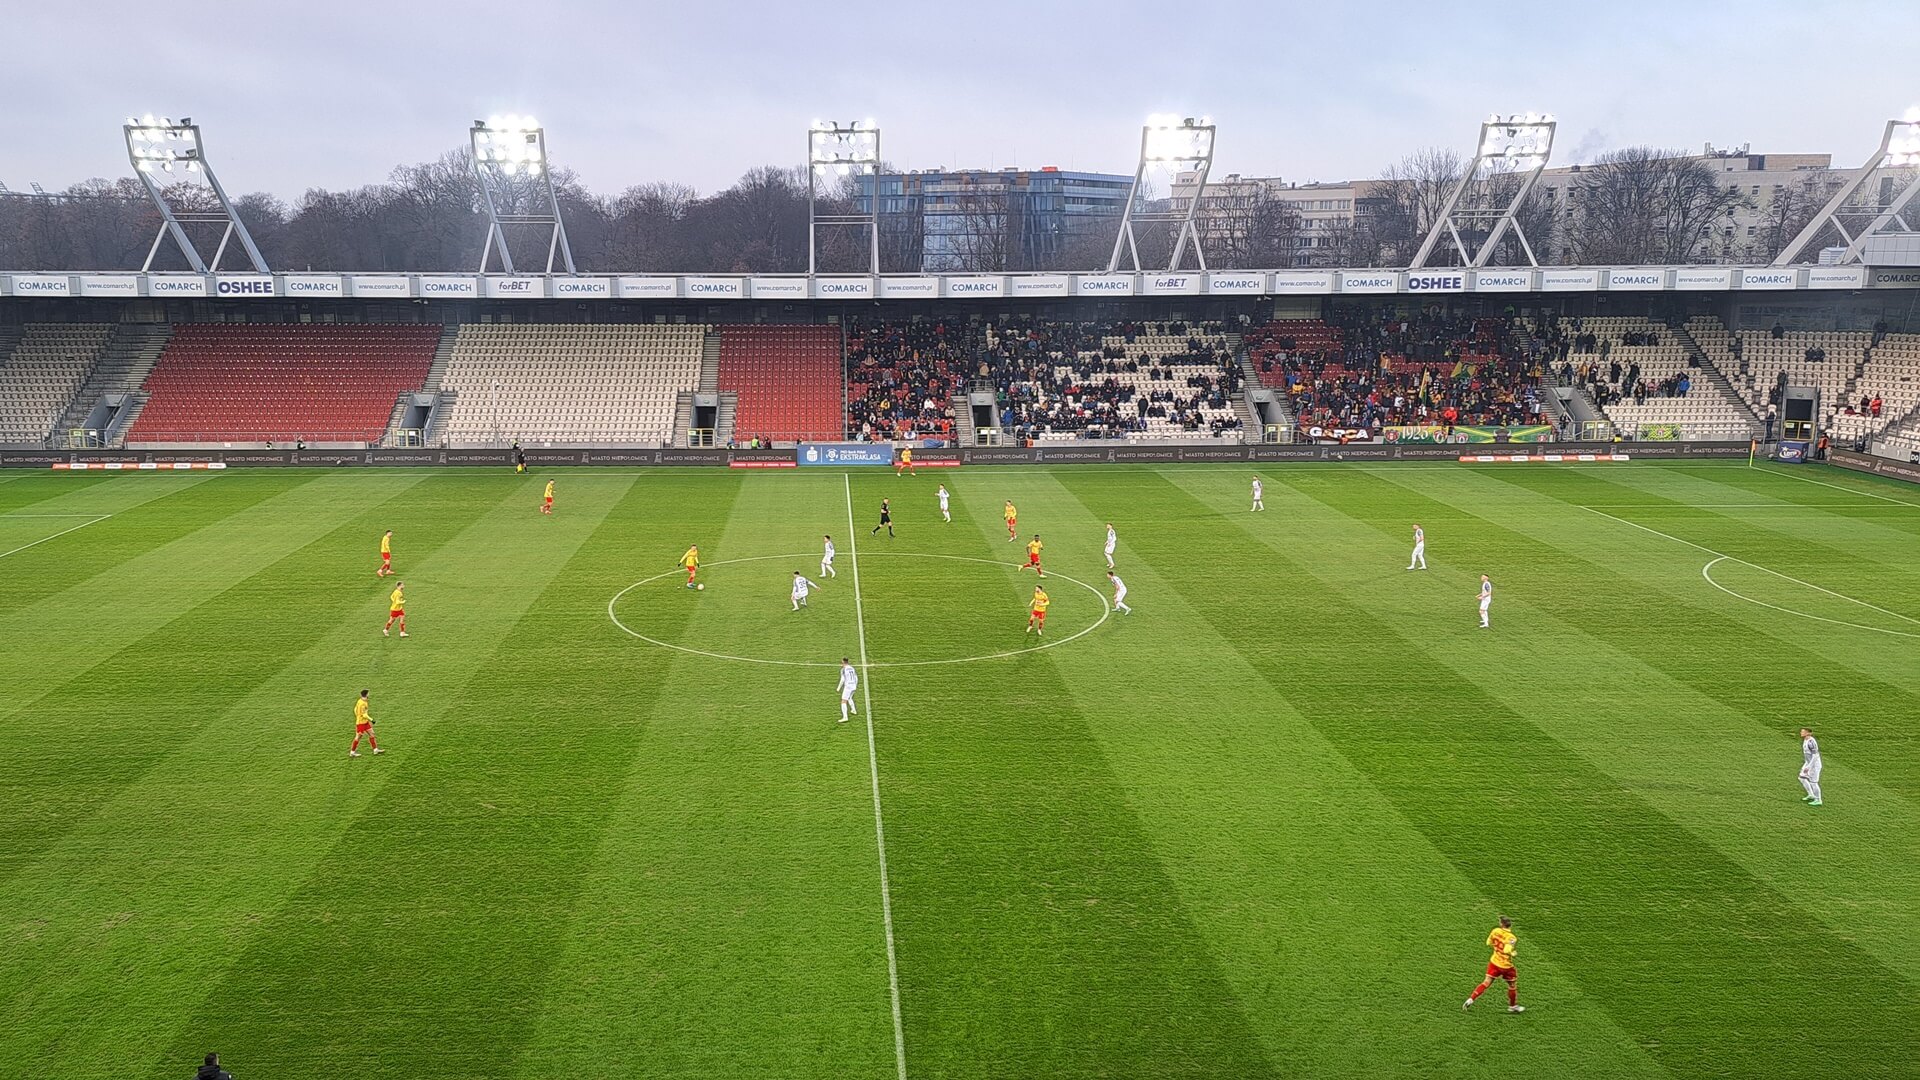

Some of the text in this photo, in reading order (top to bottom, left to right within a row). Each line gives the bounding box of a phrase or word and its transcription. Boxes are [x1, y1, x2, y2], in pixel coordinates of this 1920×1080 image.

[1877, 274, 1920, 282] COMARC
[19, 282, 66, 290] COMARCH
[290, 283, 338, 291] COMARCH
[499, 282, 530, 290] forBET
[1155, 278, 1186, 288] forBET
[1409, 278, 1462, 289] OSHEE
[218, 282, 272, 294] OSHEE
